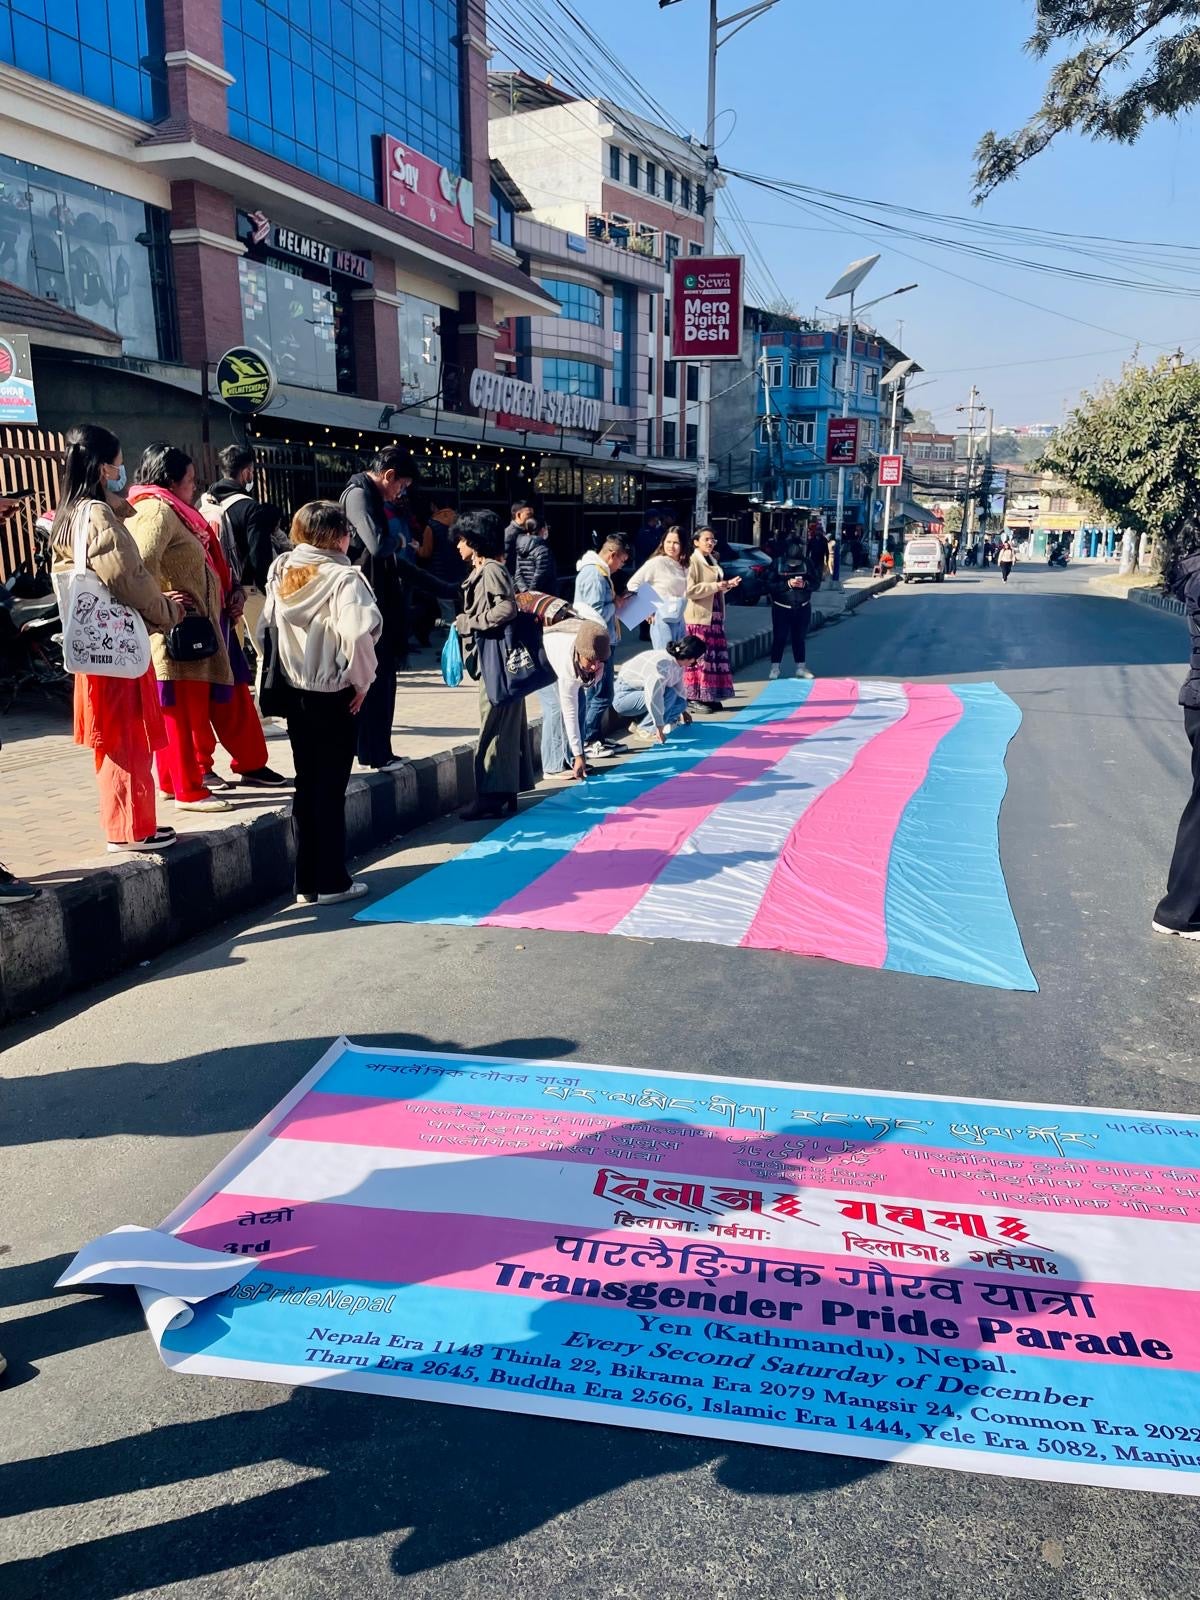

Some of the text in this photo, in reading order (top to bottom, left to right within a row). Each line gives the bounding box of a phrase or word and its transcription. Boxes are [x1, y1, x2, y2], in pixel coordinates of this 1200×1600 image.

[279, 228, 330, 263] HELMETS
[336, 250, 367, 278] NEPAL
[685, 299, 730, 314] Mero
[685, 313, 730, 328] Digital
[685, 326, 730, 341] Desh
[469, 368, 600, 432] CHICKEN STATION
[90, 655, 113, 664] WICKED
[221, 1240, 271, 1254] 3rd
[495, 1262, 1174, 1361] Transgender Pride Parade
[835, 1262, 963, 1305] गौरव
[974, 1282, 1097, 1319] यात्रा
[561, 1331, 1095, 1409] Every Second Saturday of December
[636, 1314, 1017, 1375] Yen (Kathmandu), Nepal.
[304, 1348, 369, 1367] Tharu
[376, 1354, 414, 1372] Era
[422, 1360, 479, 1383] 2645,
[488, 1368, 576, 1395] Buddha
[583, 1382, 623, 1401] Era
[631, 1388, 694, 1412] 2566,
[701, 1397, 787, 1422] Islamic
[794, 1408, 837, 1428] Era
[846, 1415, 911, 1439] 1444,
[918, 1422, 976, 1445] Yele
[983, 1430, 1029, 1451] Era
[1036, 1438, 1106, 1461] 5082,
[306, 1327, 1200, 1442] Nepala Era 1143 Thinla 22, Bikrama Era 2079 Mangsir 24, Common Era 2022
